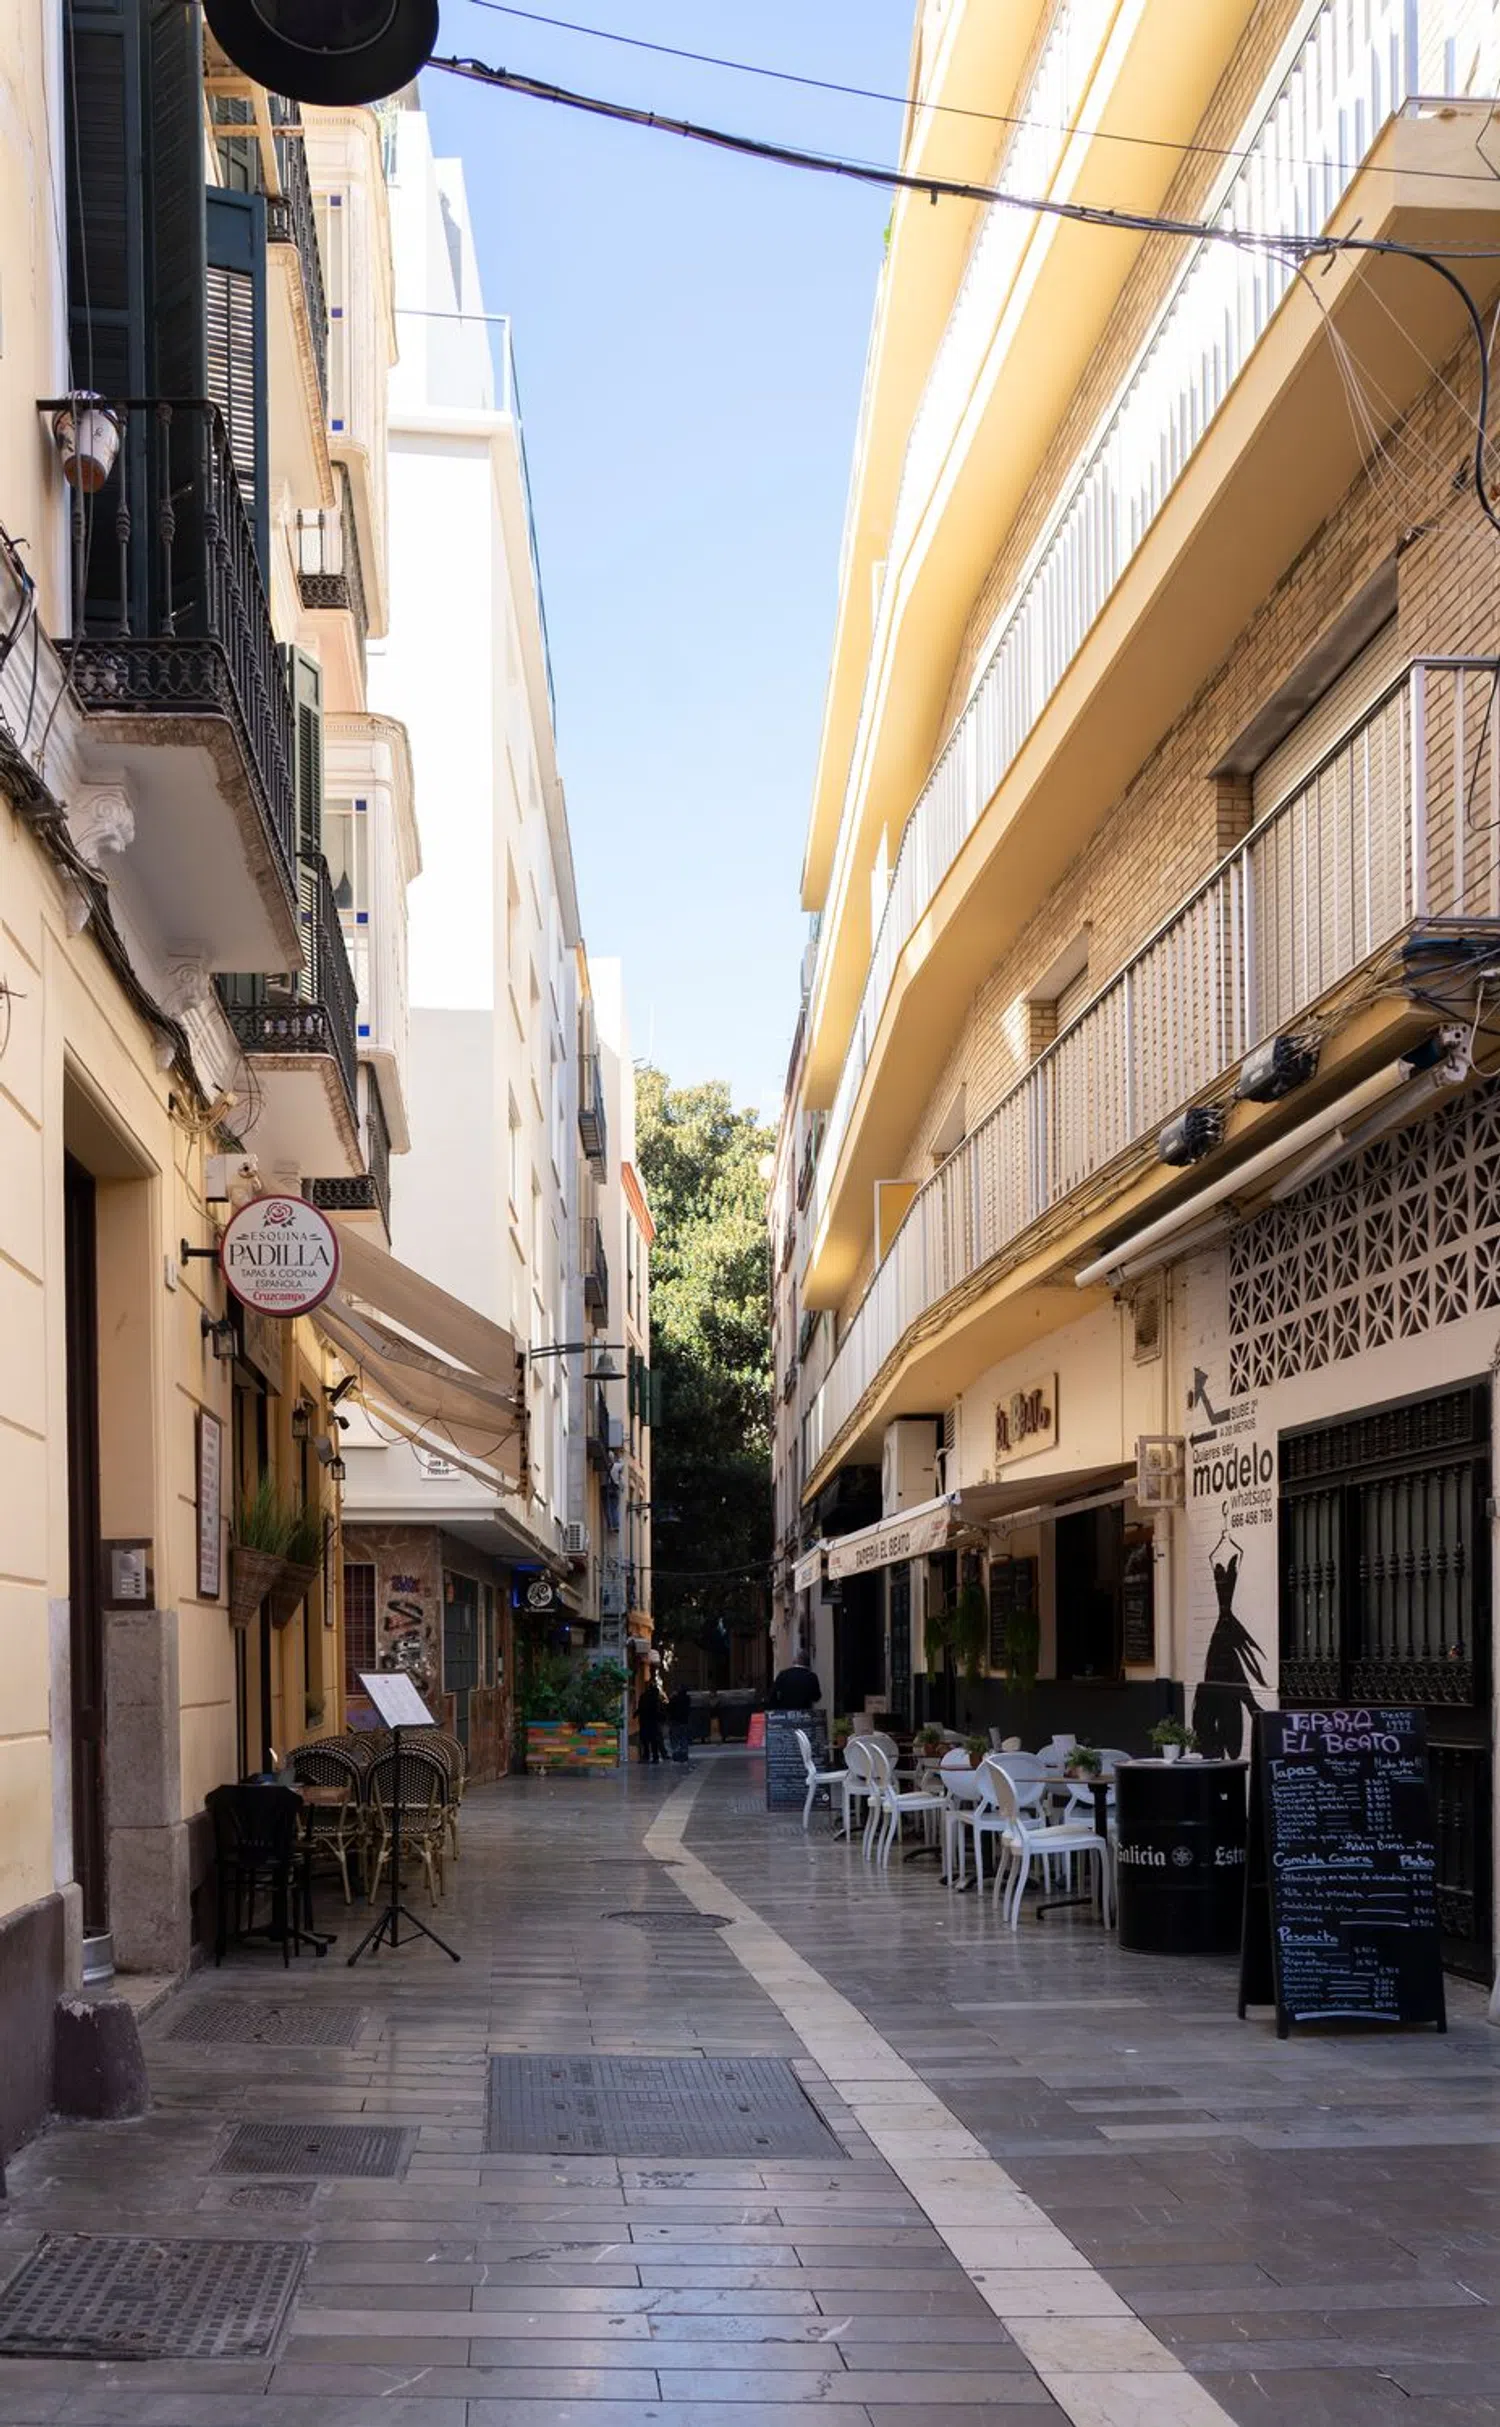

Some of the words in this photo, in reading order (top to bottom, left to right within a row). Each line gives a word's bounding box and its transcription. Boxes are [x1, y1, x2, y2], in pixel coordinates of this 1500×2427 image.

[251, 1231, 308, 1241] ESQUINA
[230, 1244, 330, 1266] PADILLA
[242, 1269, 268, 1278] TAPAS
[270, 1269, 277, 1278] &
[279, 1269, 318, 1278] COCINA
[253, 1291, 305, 1302] Cruzcampo
[1193, 1446, 1220, 1464] Quieres
[1222, 1443, 1235, 1457] ser
[1193, 1441, 1273, 1498] modelo
[1230, 1488, 1272, 1509] whatsapp
[880, 1540, 888, 1560] EL
[1281, 1728, 1315, 1754] EL
[1269, 1759, 1319, 1780] Tapas
[1272, 1851, 1325, 1867] Comida
